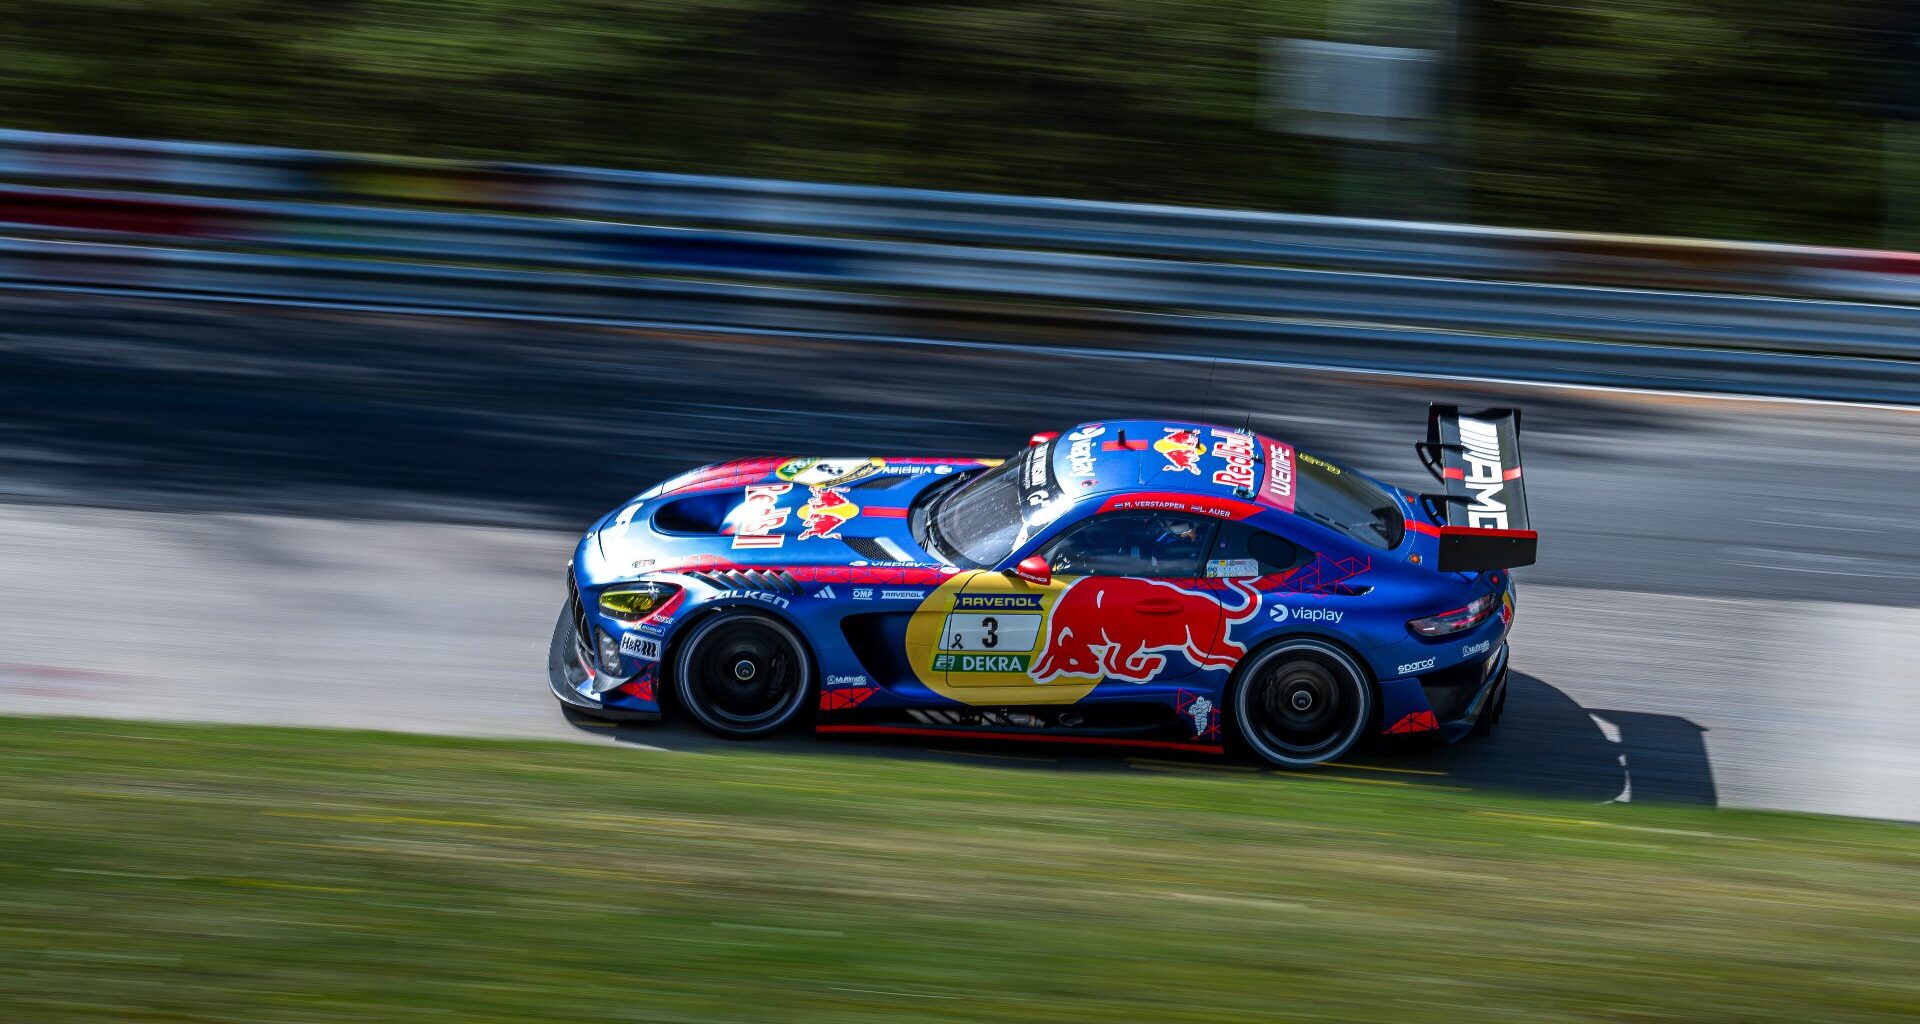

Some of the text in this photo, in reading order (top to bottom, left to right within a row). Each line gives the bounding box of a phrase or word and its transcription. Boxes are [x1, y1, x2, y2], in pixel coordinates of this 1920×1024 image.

[1270, 444, 1291, 496] WEMPE
[1135, 501, 1185, 510] VERSTAPPEN
[1209, 507, 1231, 518] AUER
[853, 590, 873, 598] OMP
[962, 597, 1037, 607] RAVENOL
[1291, 606, 1344, 623] viaplay
[981, 616, 999, 648] 3
[621, 636, 642, 652] H&R
[962, 656, 1023, 671] DEKRA
[1397, 658, 1435, 674] sparco
